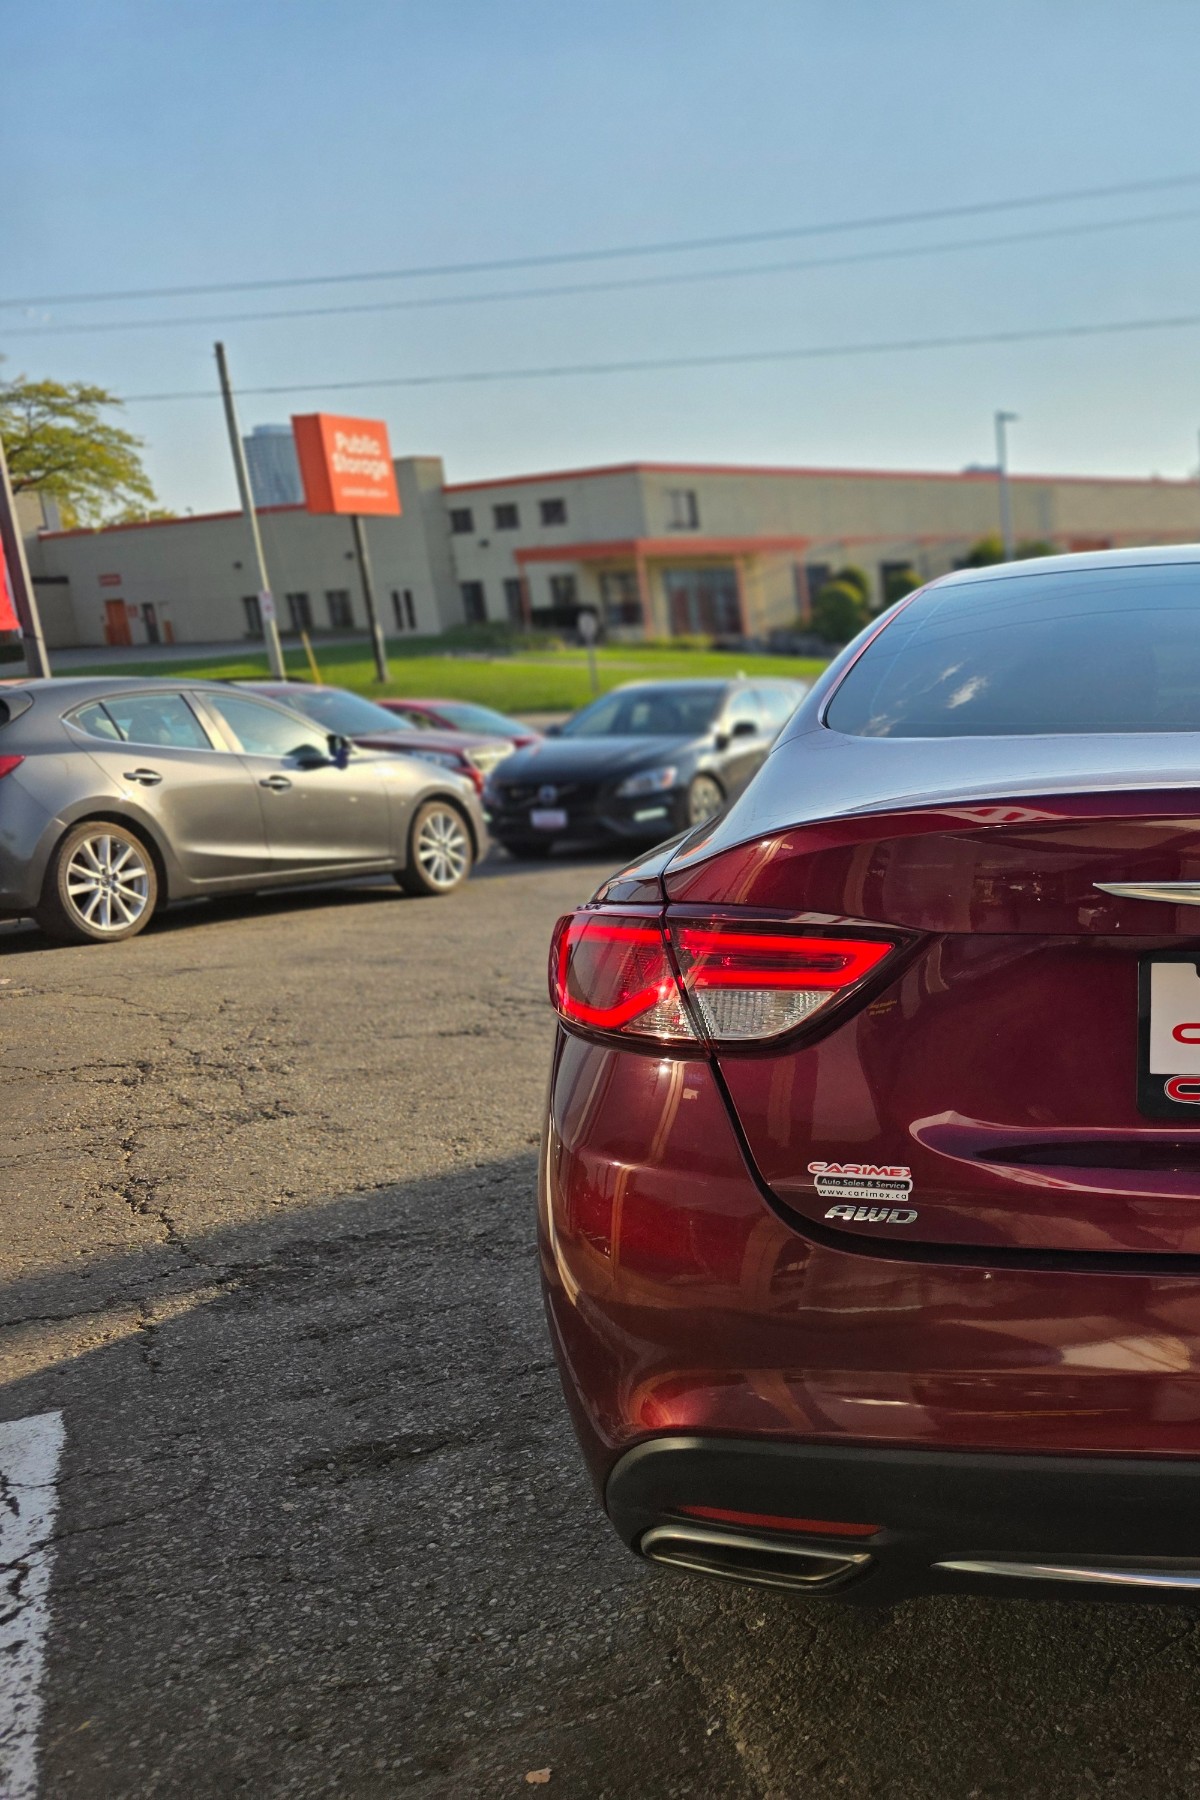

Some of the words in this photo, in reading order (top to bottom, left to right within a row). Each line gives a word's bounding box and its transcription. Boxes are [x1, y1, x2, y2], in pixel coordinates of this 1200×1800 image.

[821, 1177, 841, 1186] Auto
[843, 1179, 865, 1188] Sales
[866, 1180, 874, 1188] &
[875, 1181, 906, 1190] Service
[819, 1188, 907, 1200] www.carimex.ca
[824, 1204, 918, 1224] AWD
